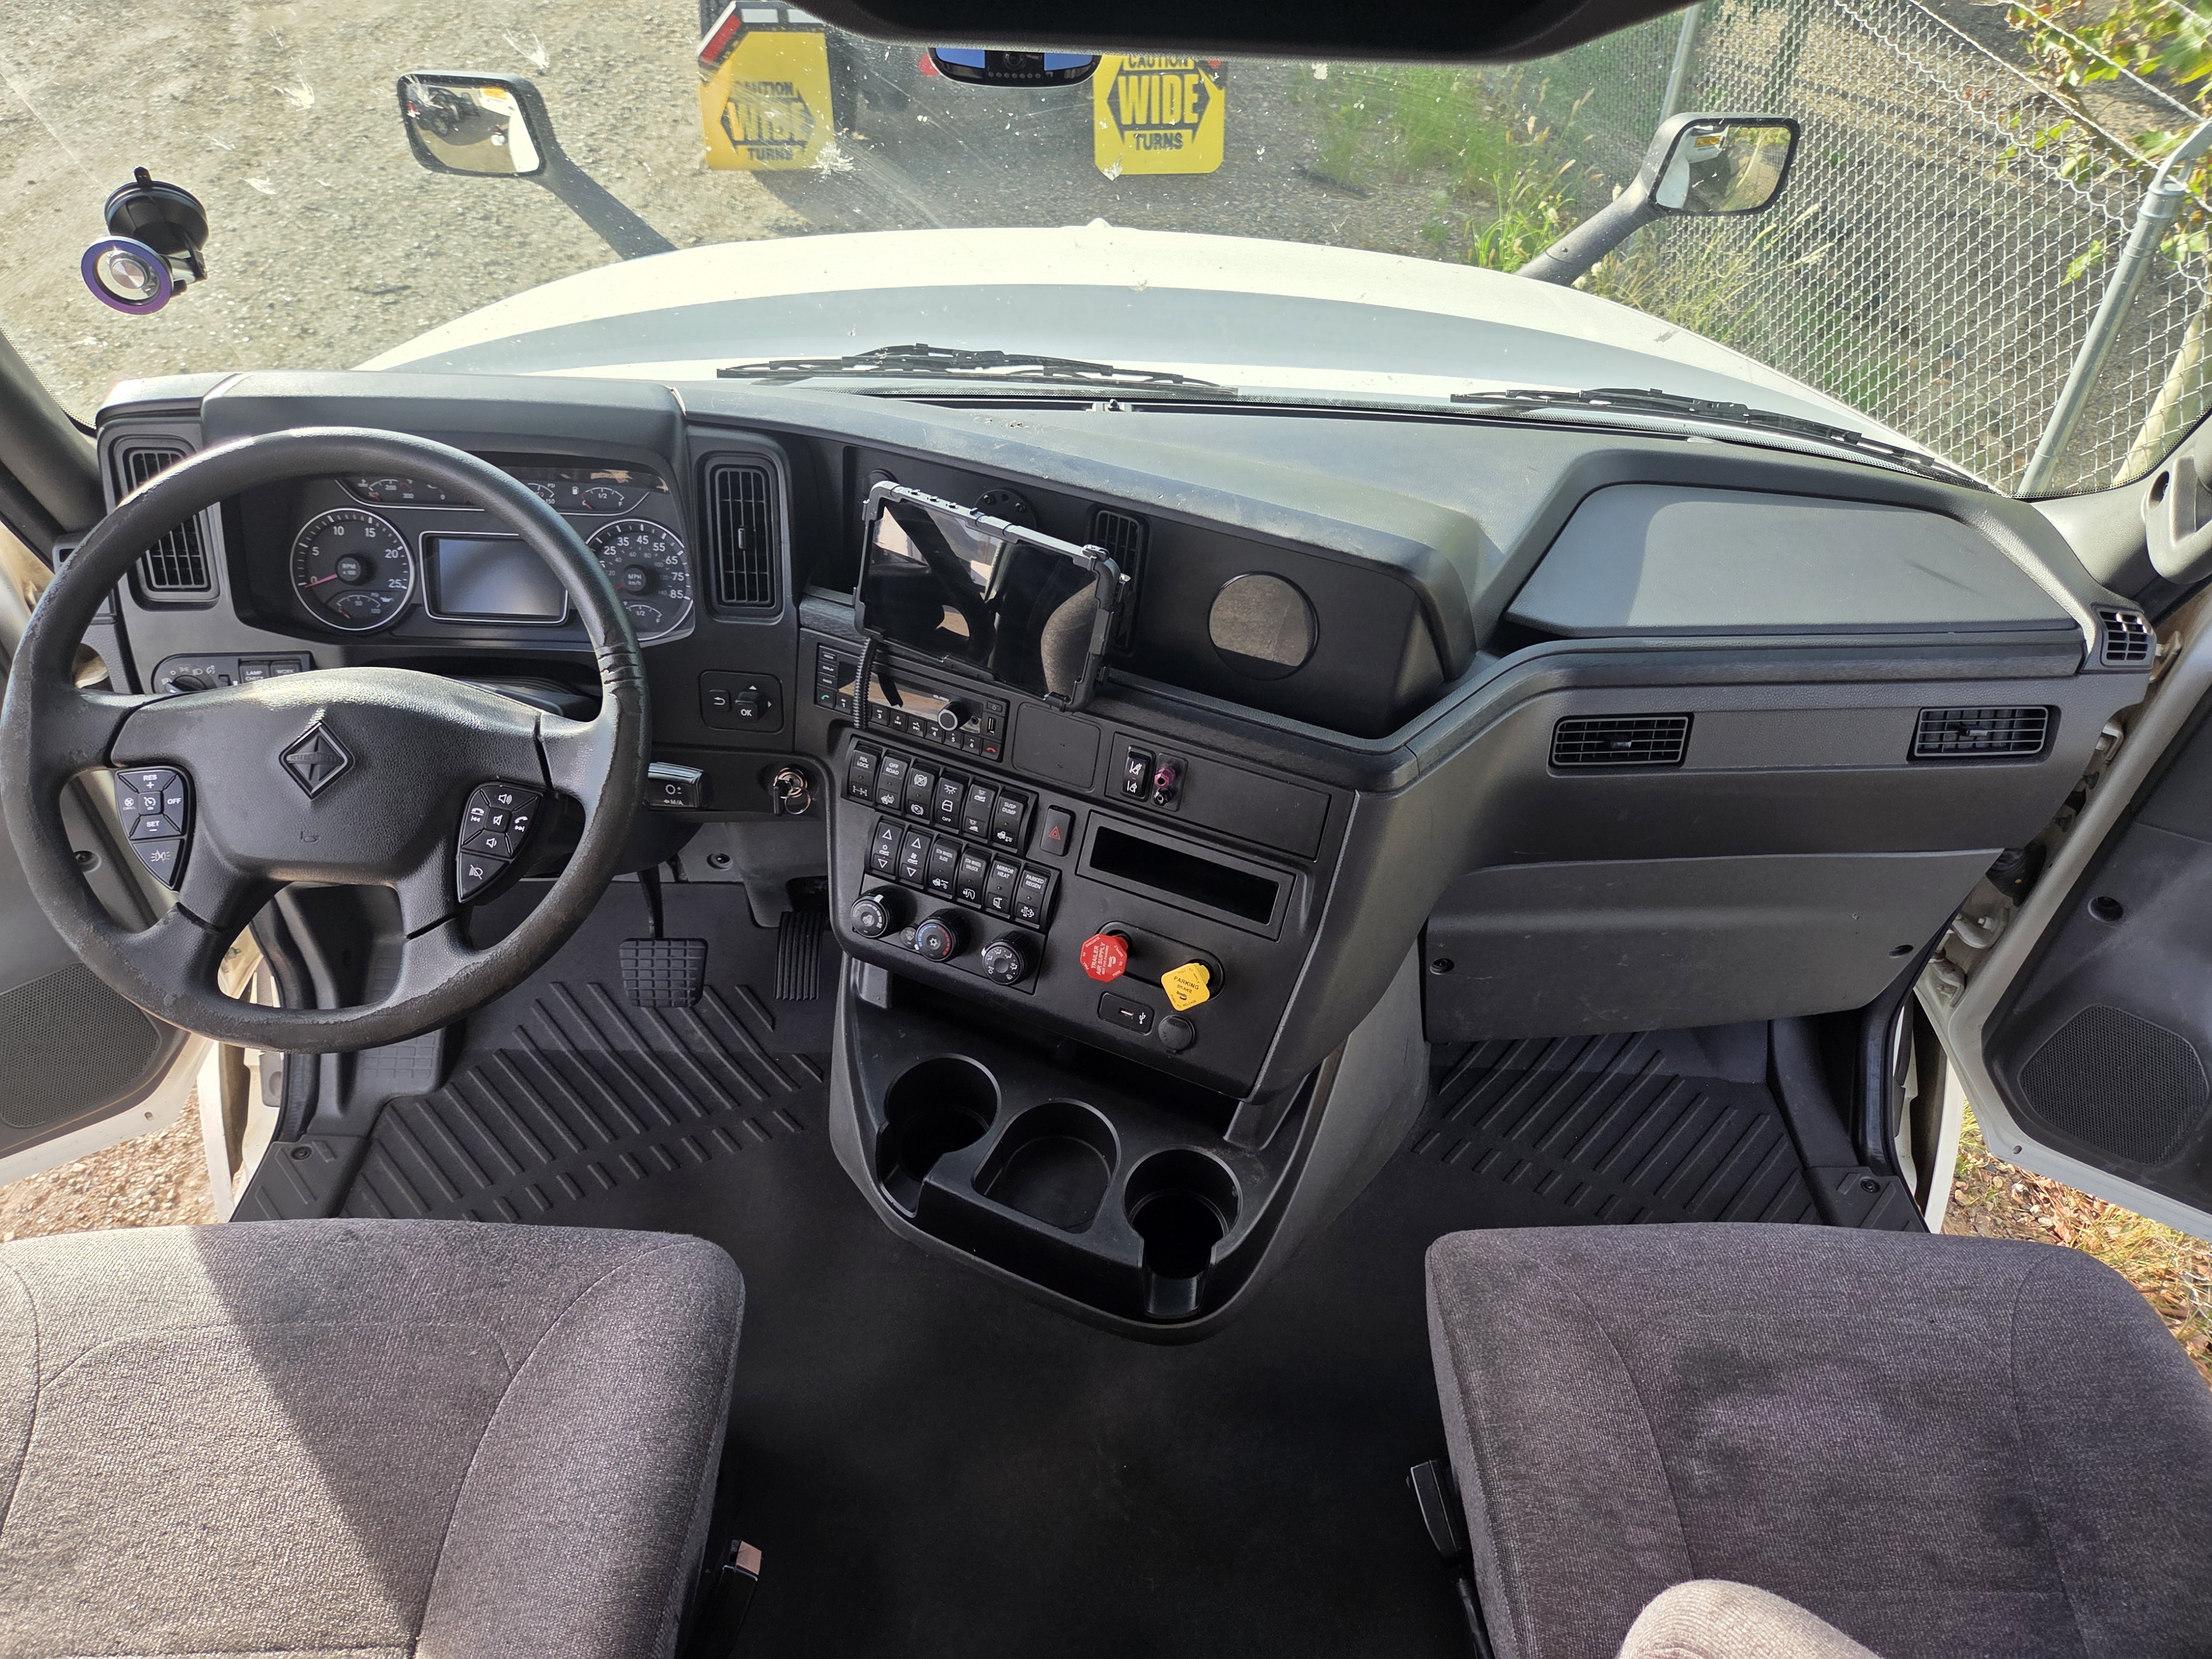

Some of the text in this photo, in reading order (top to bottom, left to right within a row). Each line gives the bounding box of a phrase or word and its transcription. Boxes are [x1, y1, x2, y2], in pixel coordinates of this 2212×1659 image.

[1128, 55, 1189, 68] CAUTION
[1118, 74, 1199, 124] WIDE
[1134, 132, 1184, 151] TURNS
[747, 147, 794, 161] TURNS
[333, 525, 345, 535] 10
[365, 528, 376, 538] 15
[617, 537, 629, 546] 35
[637, 535, 649, 545] 45
[312, 546, 319, 556] 5
[603, 546, 617, 555] 25
[653, 542, 666, 552] 55
[384, 549, 399, 559] 20
[665, 556, 678, 565] 65
[310, 576, 318, 584] 0
[671, 572, 685, 581] 75
[388, 578, 401, 588] 25
[670, 589, 684, 599] 85
[996, 864, 1014, 874] MIRROR
[1025, 874, 1044, 884] PARKED
[1025, 880, 1041, 889] REGEN
[1173, 976, 1199, 990] PARKING
[1177, 984, 1192, 993] BRAKE
